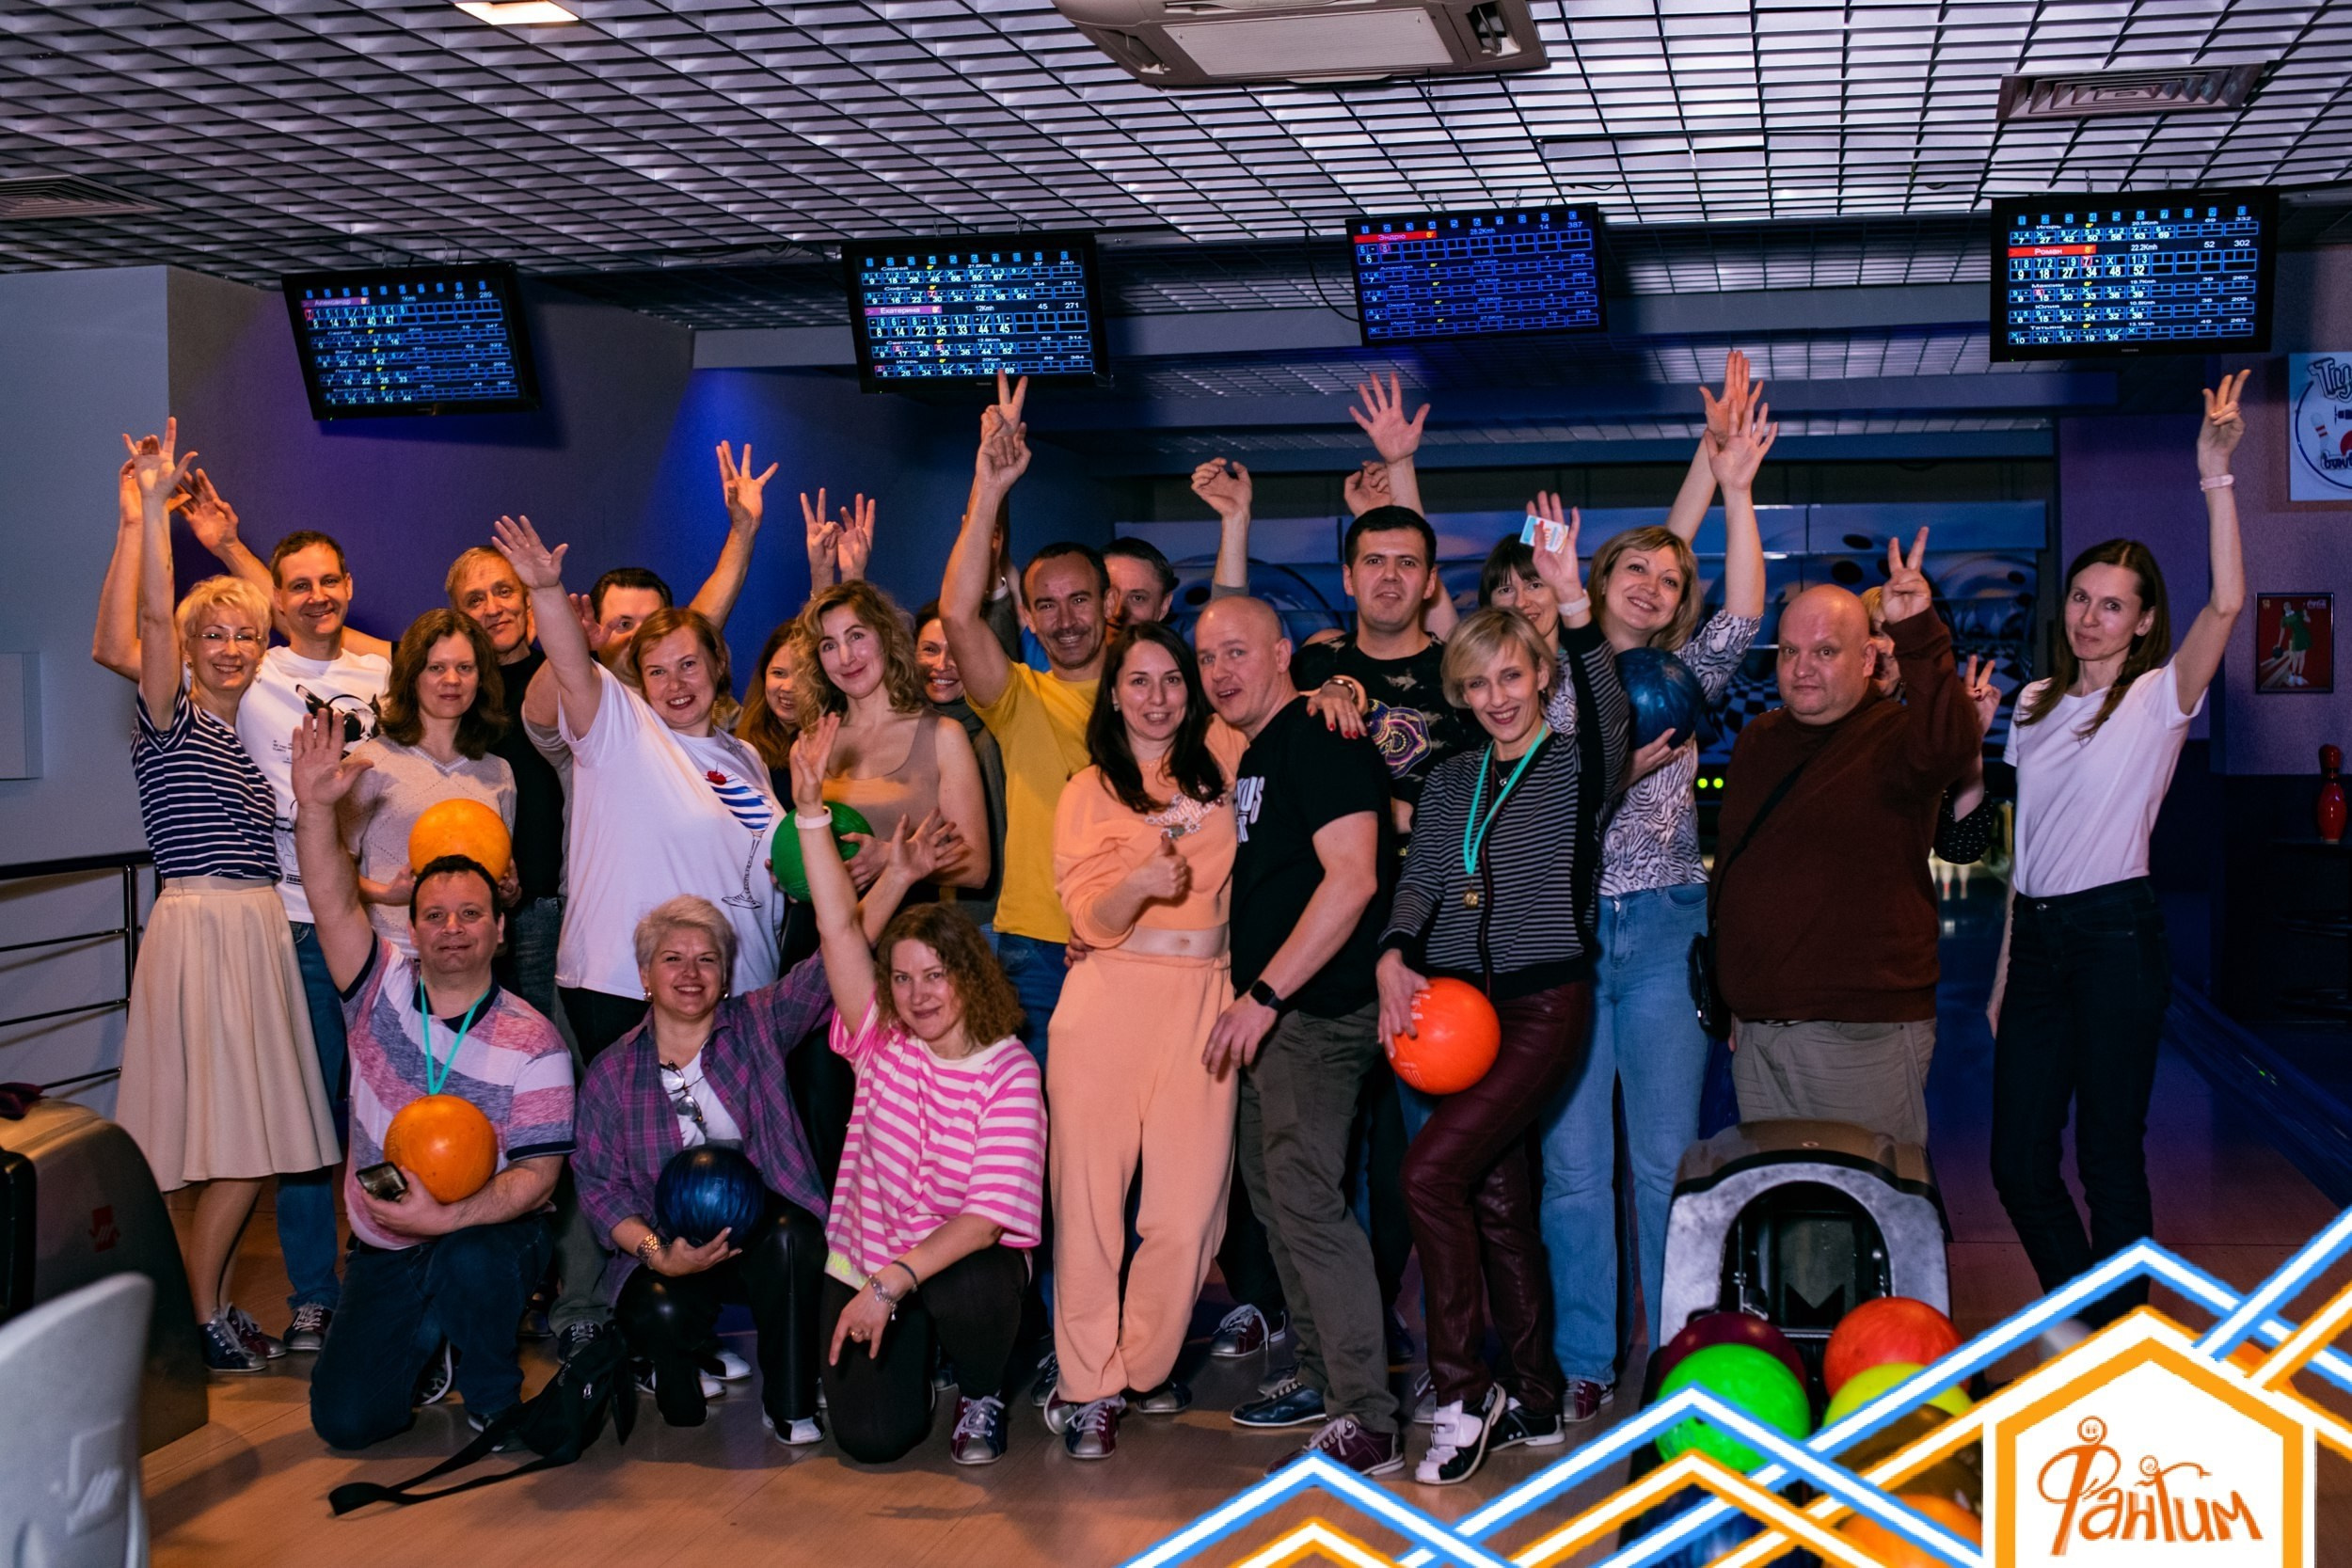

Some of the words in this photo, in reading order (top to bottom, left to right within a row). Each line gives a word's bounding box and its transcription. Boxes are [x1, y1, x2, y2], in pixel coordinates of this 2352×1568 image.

[1366, 255, 1372, 263] 6
[2047, 259, 2053, 267] 2
[2071, 258, 2076, 266] 9
[2142, 255, 2147, 263] 3
[2018, 270, 2024, 280] 9
[2040, 270, 2050, 279] 18
[2062, 268, 2074, 278] 27
[2087, 268, 2097, 277] 34
[2109, 266, 2121, 277] 48
[2133, 265, 2145, 276] 52
[330, 319, 339, 327] 14
[386, 315, 394, 325] 47
[877, 327, 882, 337] 8
[895, 327, 905, 337] 14
[915, 327, 926, 336] 22
[936, 326, 947, 336] 25
[957, 325, 967, 335] 33
[978, 325, 989, 334] 44
[999, 325, 1010, 333] 45
